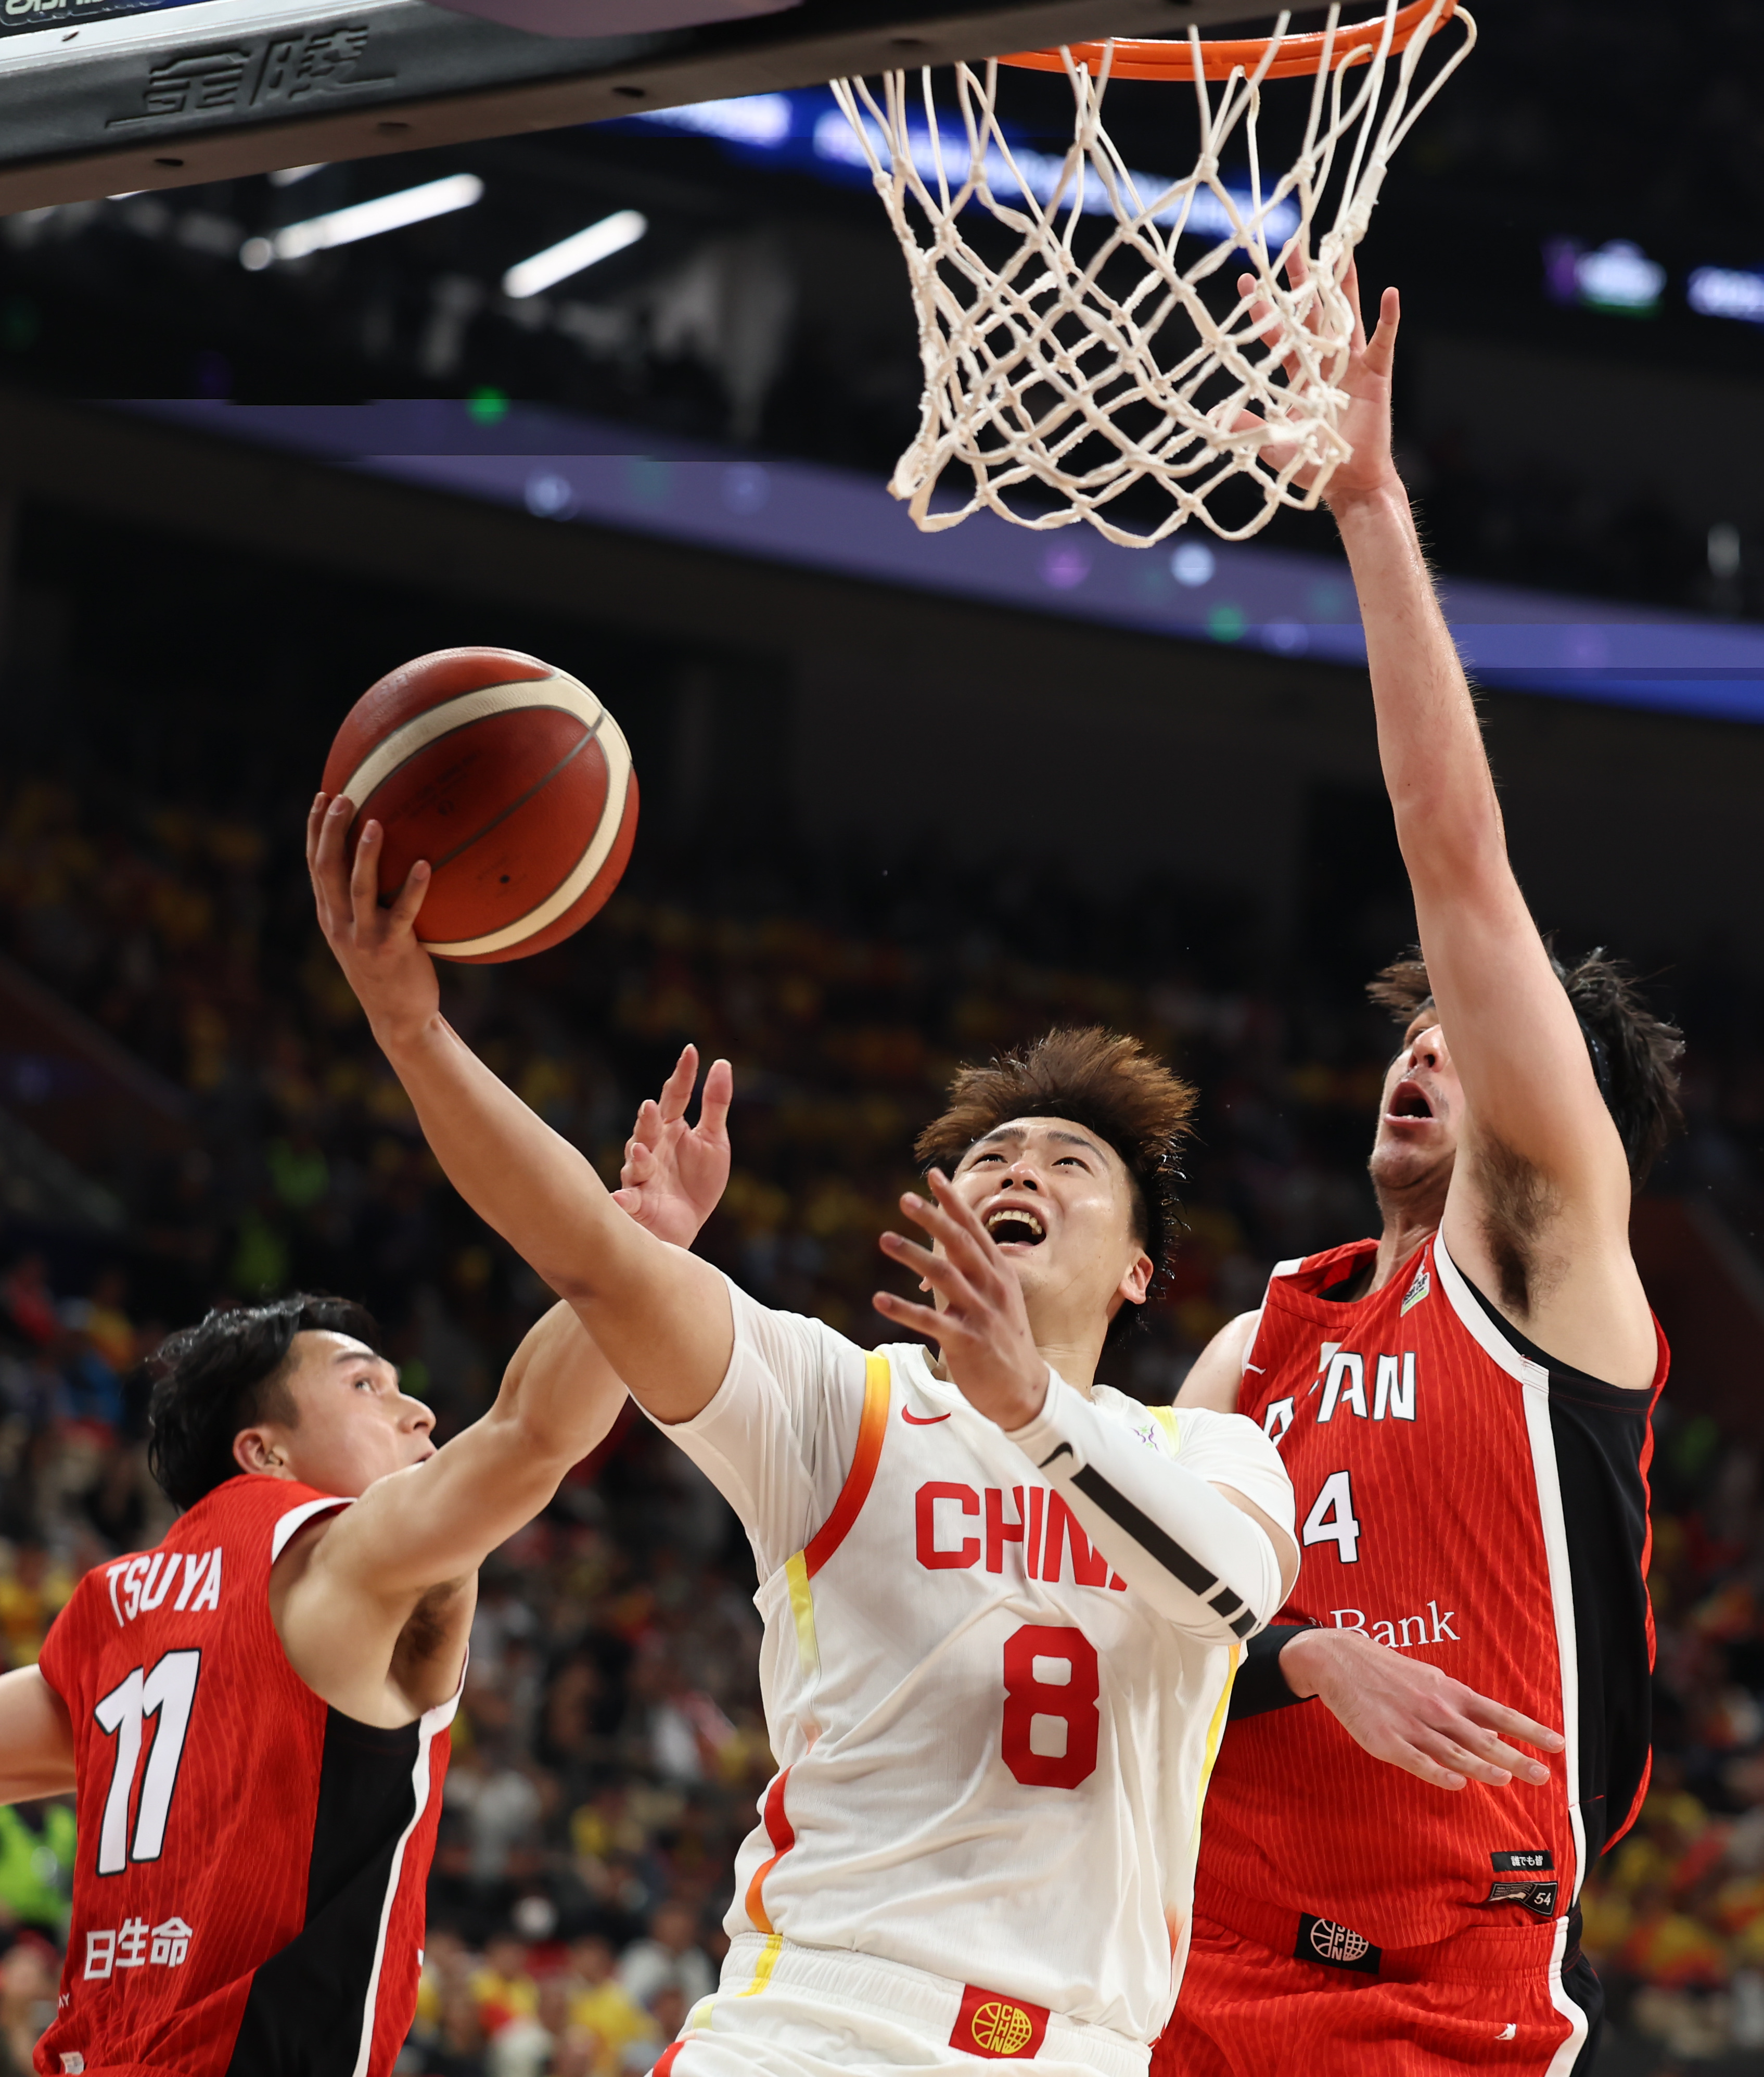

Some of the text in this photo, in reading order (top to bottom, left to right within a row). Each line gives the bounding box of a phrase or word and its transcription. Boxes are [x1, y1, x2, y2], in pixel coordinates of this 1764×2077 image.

[915, 1481, 1128, 1591] CHIN
[1302, 1470, 1360, 1563] 4
[106, 1546, 223, 1628] TSUYA
[1330, 1600, 1461, 1648] Bank
[1001, 1624, 1100, 1790] 8
[94, 1648, 201, 1877] 11
[1533, 1892, 1552, 1906] 54
[990, 2005, 1013, 2053] CHN
